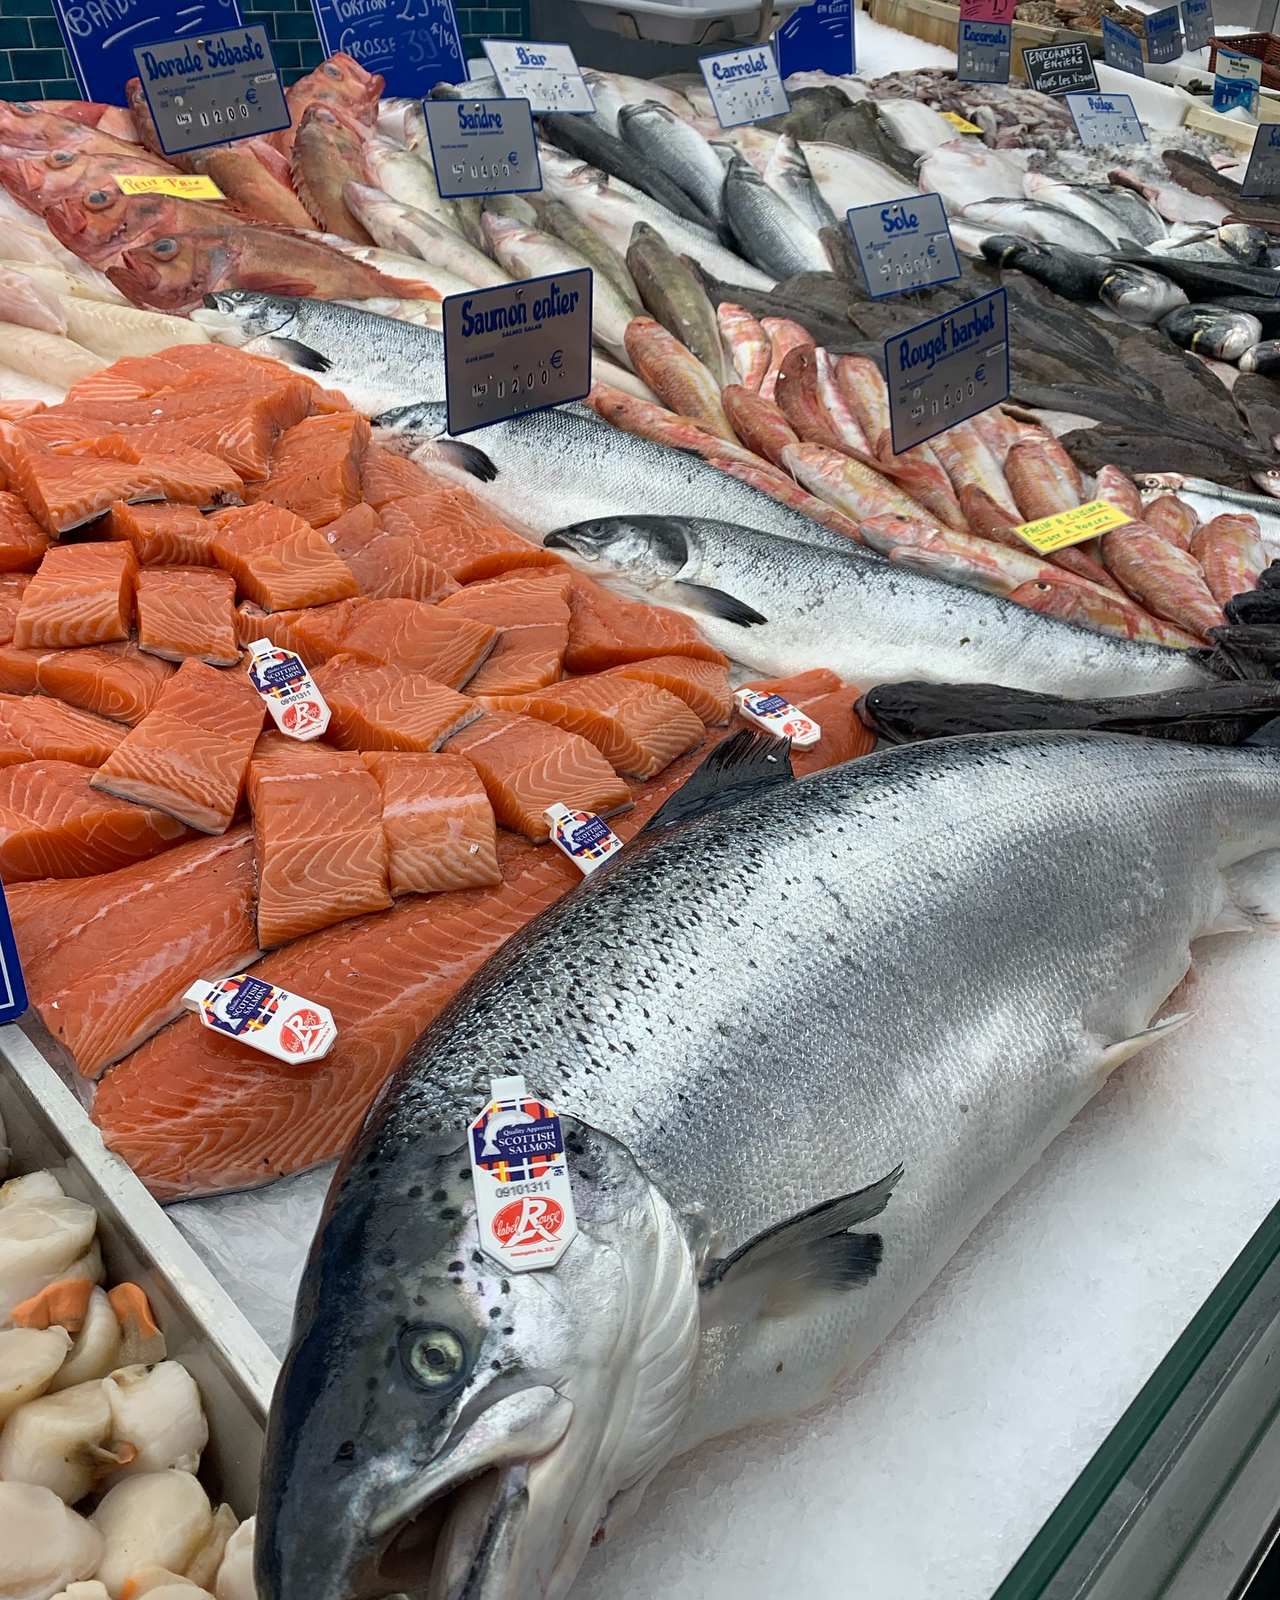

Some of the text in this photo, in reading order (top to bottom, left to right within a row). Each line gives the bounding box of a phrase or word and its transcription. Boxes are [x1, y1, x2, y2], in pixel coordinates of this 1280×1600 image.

[141, 44, 203, 80] Dorade
[205, 33, 265, 68] Sébaste
[516, 46, 546, 65] Bar
[711, 52, 768, 80] Carrelet
[457, 104, 504, 129] Sandre
[880, 206, 919, 232] Sole
[462, 282, 579, 337] Saumon entier
[900, 321, 947, 371] Rouget
[951, 302, 995, 348] barbet
[550, 350, 564, 369] €
[266, 665, 300, 680] SCOTTISH
[575, 823, 604, 842] SCOTTISH
[232, 983, 262, 1017] SCOTTISH
[243, 985, 268, 1016] SALMON
[498, 1131, 556, 1147] SCOTTISH
[503, 1124, 554, 1137] Quality Approved
[509, 1141, 557, 1155] SALMON
[495, 1181, 551, 1198] 09101311
